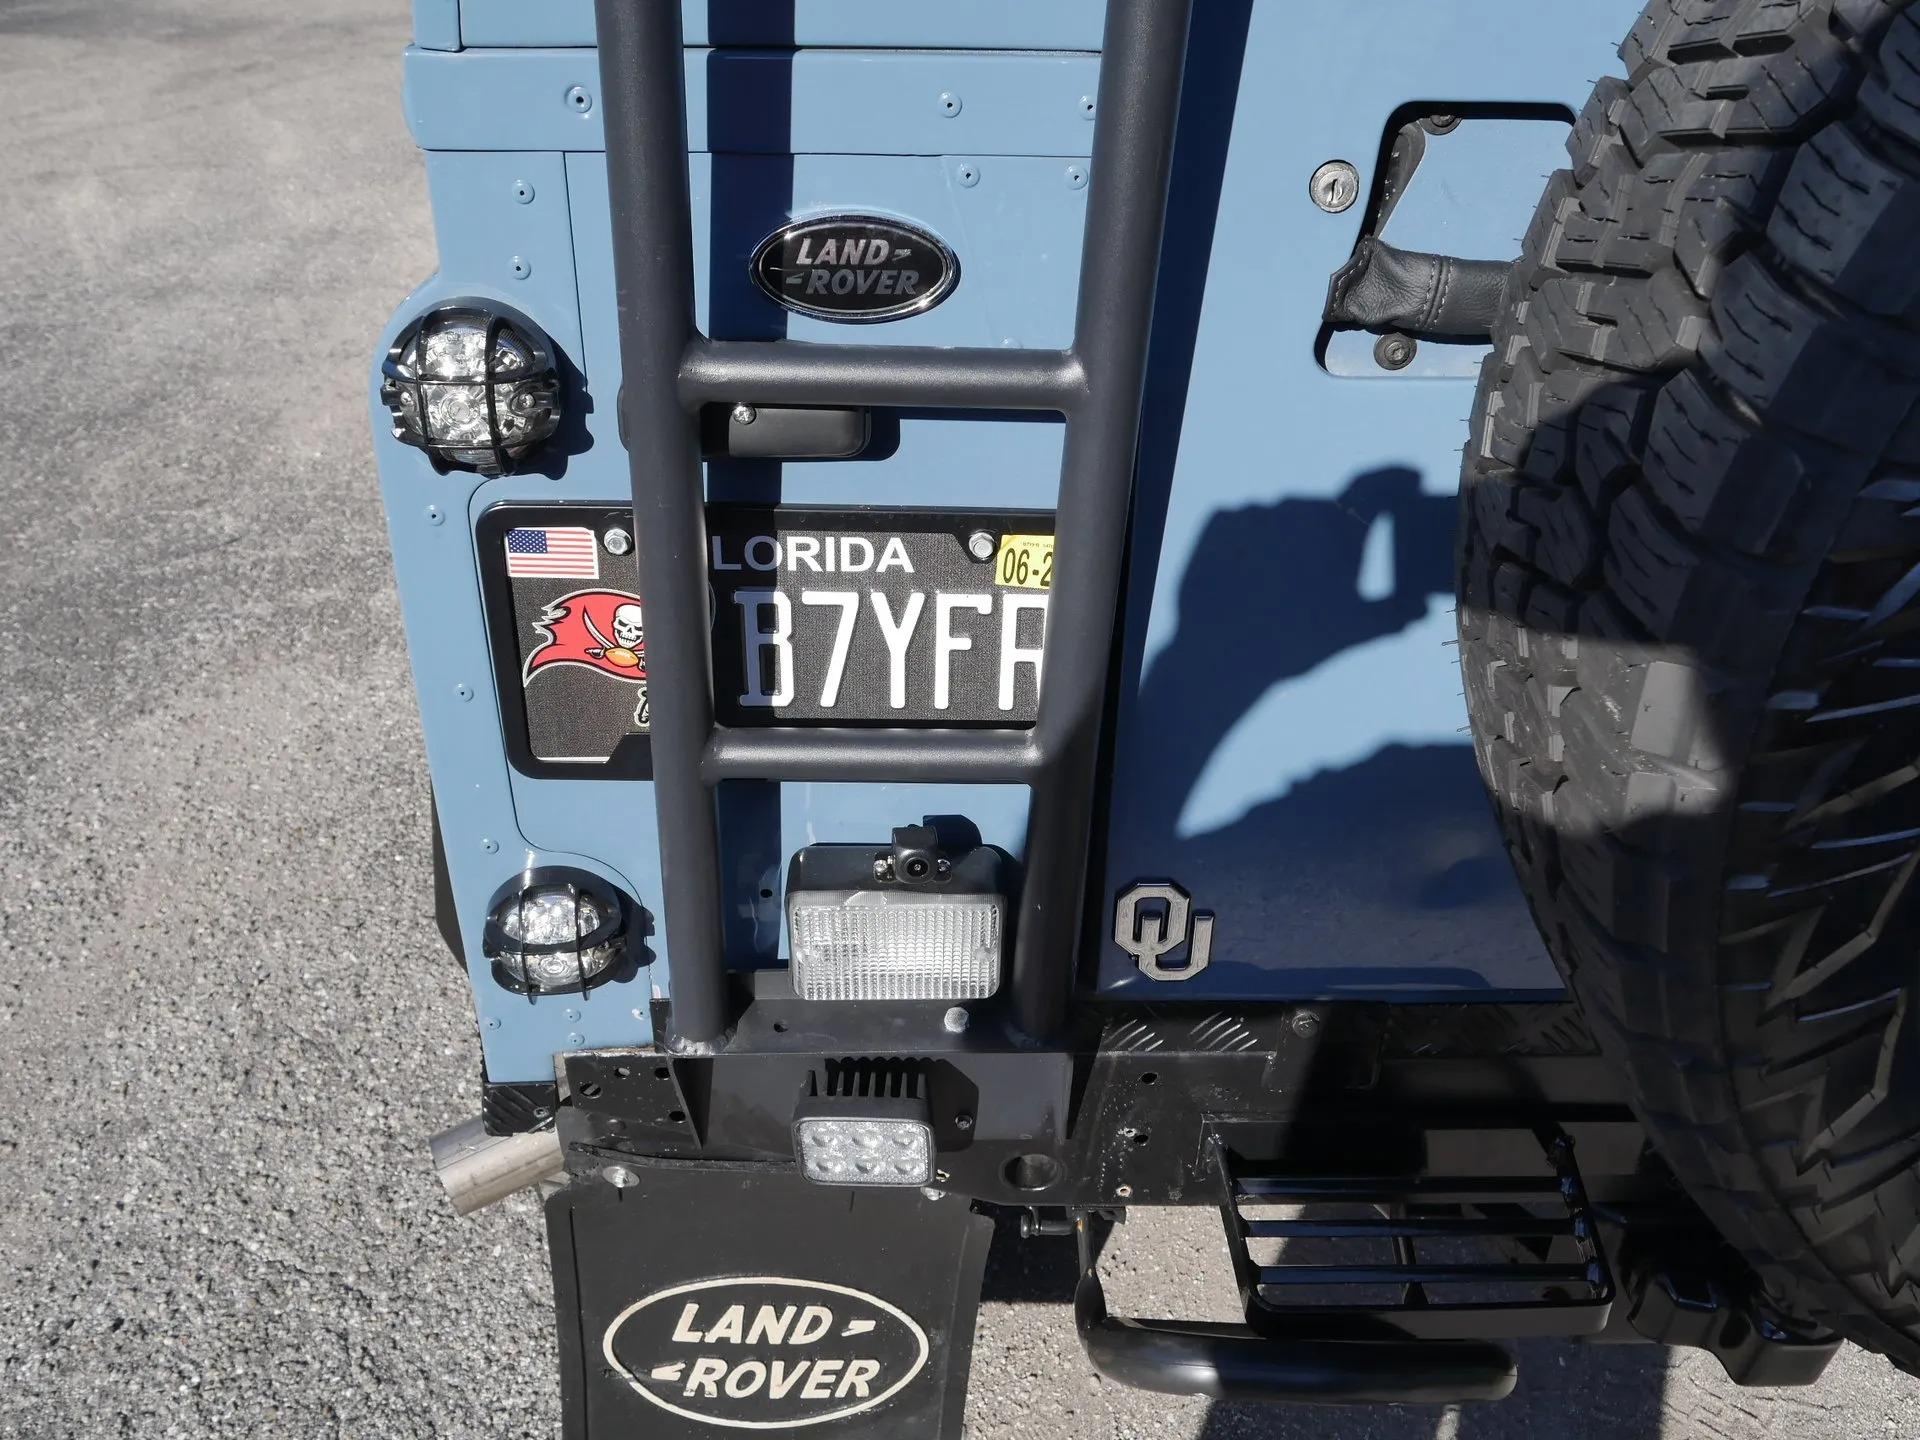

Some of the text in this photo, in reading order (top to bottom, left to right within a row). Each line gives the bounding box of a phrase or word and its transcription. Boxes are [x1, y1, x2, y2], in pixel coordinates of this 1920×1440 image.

[796, 238, 889, 265] LAND
[805, 269, 919, 295] ROVER
[712, 535, 915, 573] LORIDA
[1114, 882, 1214, 981] OU
[672, 1303, 834, 1345] LAND
[684, 1358, 881, 1400] ROVER
